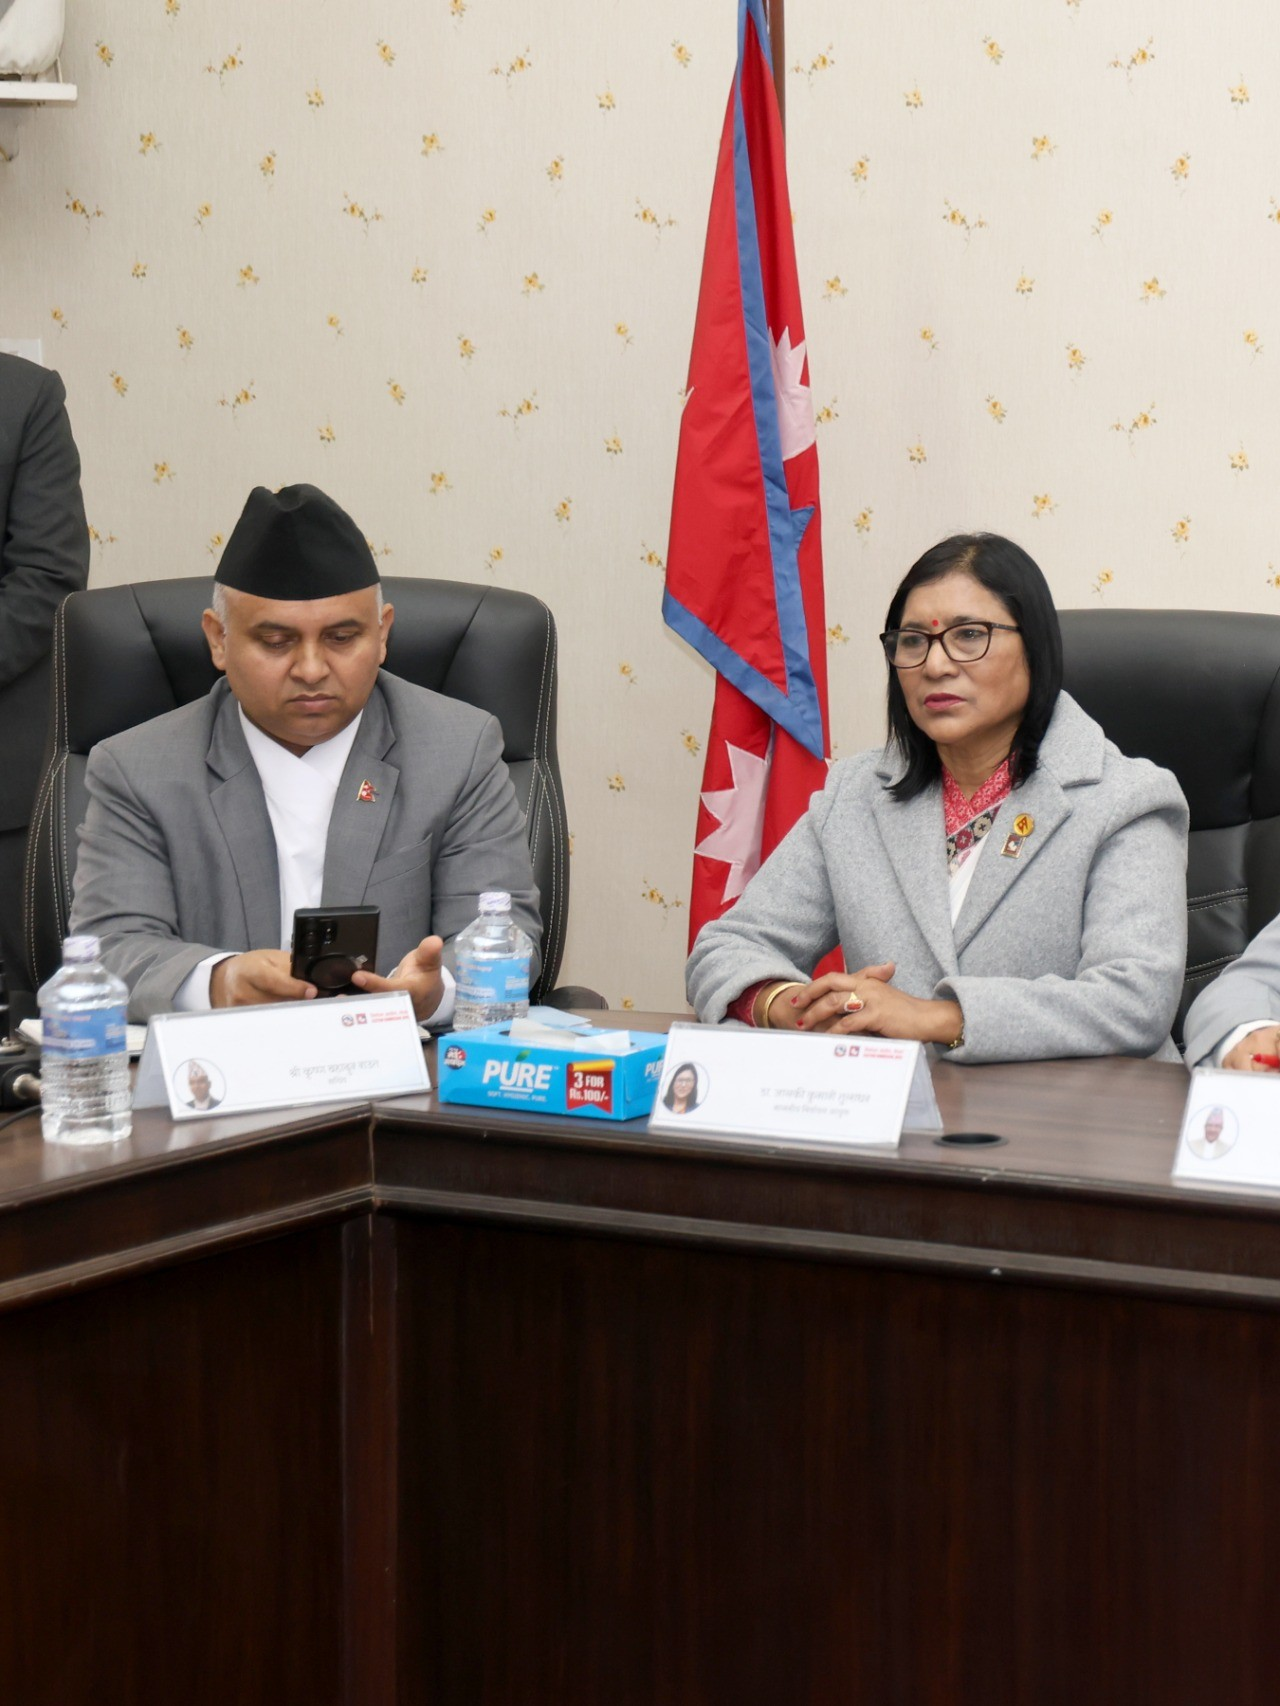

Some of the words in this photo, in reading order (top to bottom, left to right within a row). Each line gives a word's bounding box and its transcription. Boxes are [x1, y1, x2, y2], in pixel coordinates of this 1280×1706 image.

[482, 1059, 553, 1090] PURE
[574, 1072, 583, 1088] 3
[585, 1075, 604, 1088] FOR
